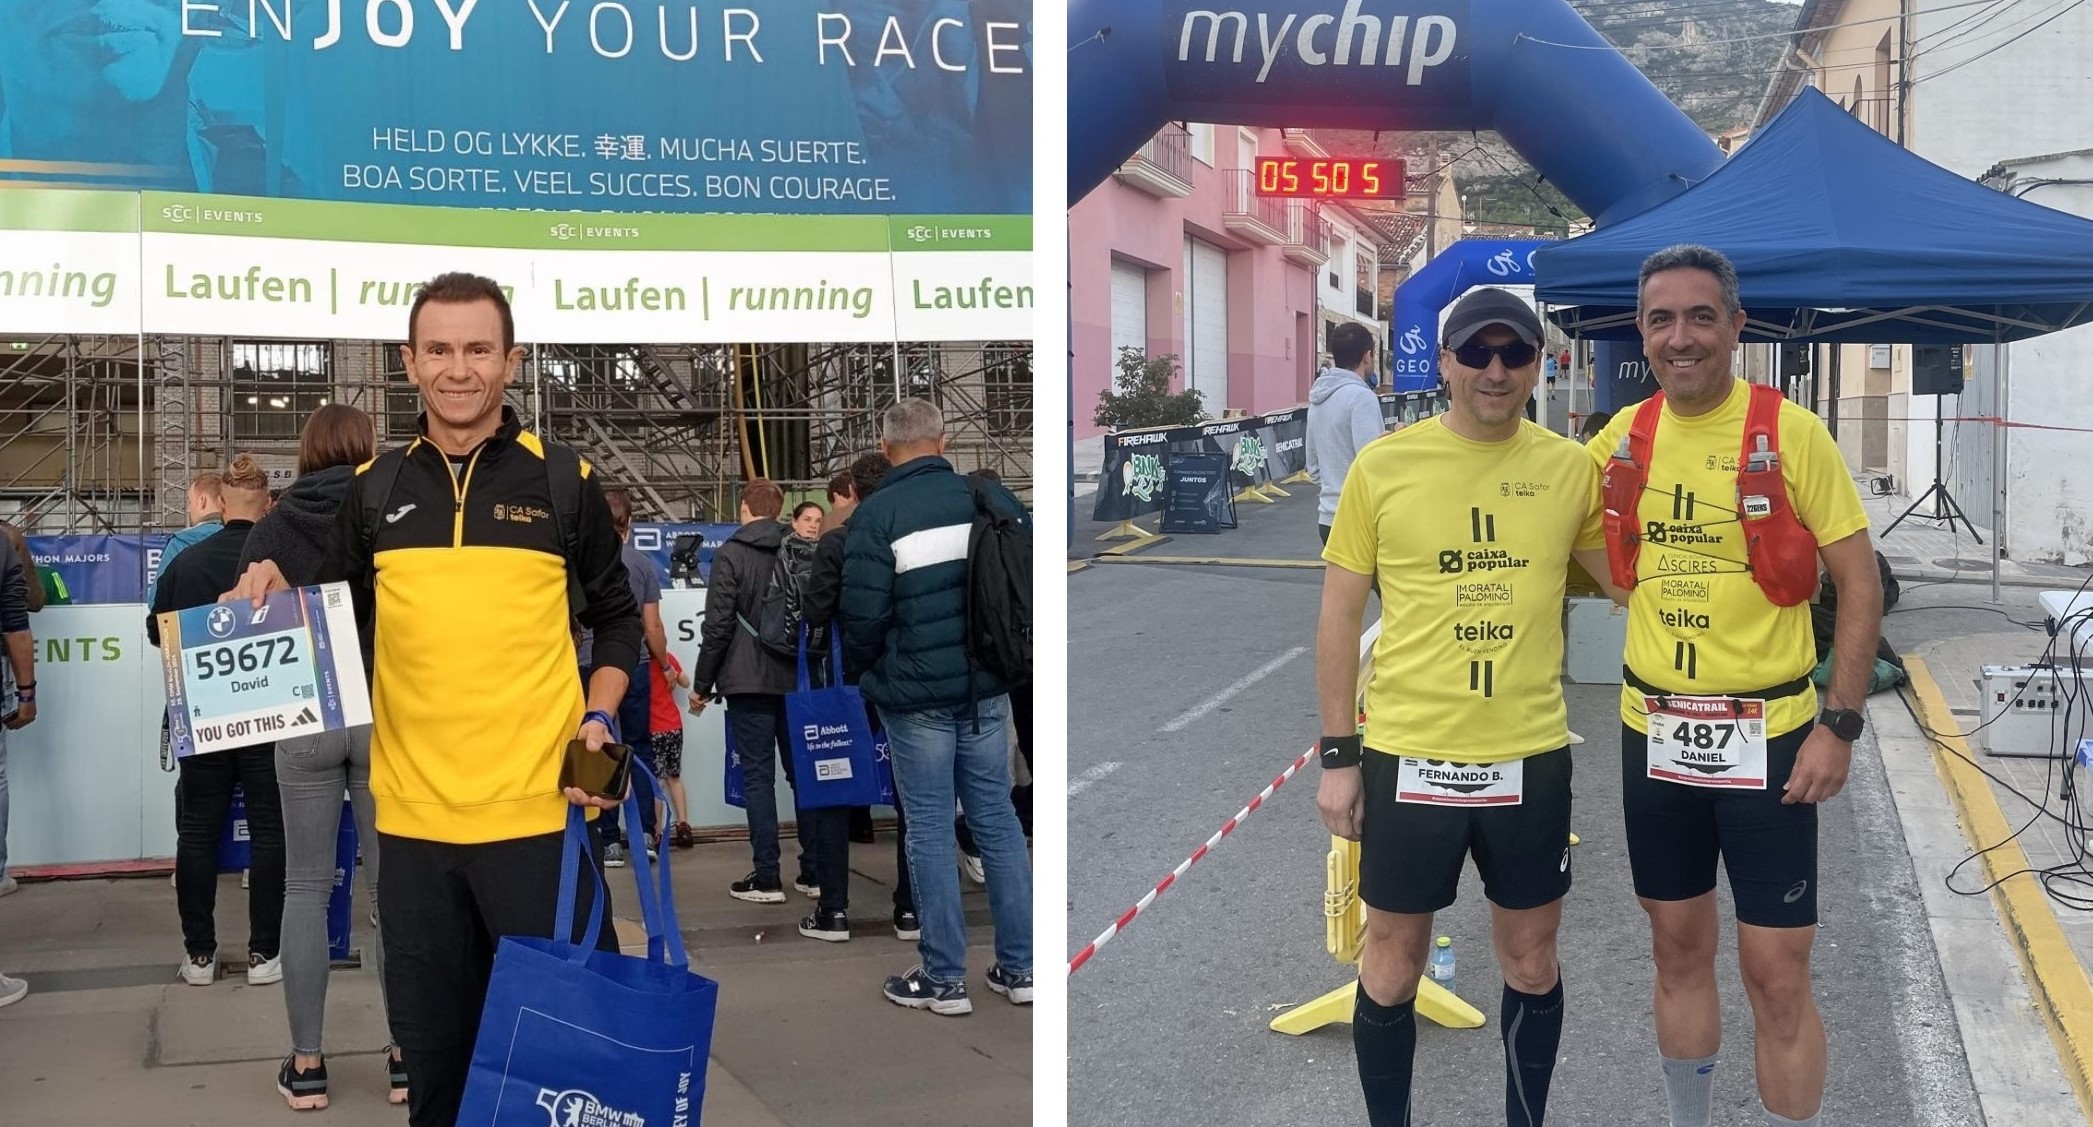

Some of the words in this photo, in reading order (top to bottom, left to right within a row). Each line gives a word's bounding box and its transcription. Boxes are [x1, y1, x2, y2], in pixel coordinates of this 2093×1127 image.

[181, 0, 477, 51] ENJOY
[527, 0, 763, 63] YOUR
[818, 12, 1024, 74] RACE
[1178, 0, 1457, 85] mychip
[372, 127, 445, 153] HELD
[454, 131, 492, 155] OG
[501, 132, 587, 158] LYKKE.
[660, 137, 754, 162] MUCHA
[761, 140, 867, 165] SUERTE.
[344, 164, 402, 190] BOA
[409, 167, 508, 193] SORTE.
[514, 170, 582, 195] VEEL
[590, 173, 698, 198] SUCCES.
[706, 175, 761, 199] BON
[770, 177, 896, 201] COURAGE.
[1260, 161, 1298, 192] 05
[1312, 162, 1349, 193] 50
[1362, 163, 1379, 194] 5
[204, 210, 263, 223] EVENTS
[586, 227, 639, 239] EVENTS
[942, 228, 991, 240] EVENTS
[166, 264, 312, 304] Laufen
[554, 278, 686, 312] Laufen
[729, 279, 874, 319] running
[912, 279, 1033, 310] Laufen
[1396, 359, 1430, 373] GEO
[1118, 432, 1169, 448] FIREHAWK
[1180, 476, 1207, 484] JUNTOS
[1514, 482, 1527, 490] CA
[509, 505, 523, 514] CA
[1670, 533, 1723, 545] popular
[64, 553, 110, 563] MAJORS
[1467, 549, 1507, 560] caixa
[1467, 557, 1529, 572] popular
[1459, 584, 1509, 593] MORATAL
[1663, 580, 1706, 589] MORATAL
[1459, 592, 1510, 602] PALOMINO
[1663, 588, 1706, 598] PALOMINO
[1659, 607, 1709, 629] teika
[1454, 620, 1513, 641] teika
[196, 635, 299, 680] 59672
[231, 675, 269, 694] David
[196, 728, 222, 743] YOU
[226, 720, 251, 738] GOT
[254, 713, 286, 733] THIS
[820, 723, 849, 736] Abbott
[1672, 721, 1735, 750] 487
[1681, 750, 1726, 763] DANIEL
[1418, 768, 1489, 782] FERNANDO
[1492, 771, 1504, 781] B.
[678, 1072, 691, 1094] JOY
[584, 1100, 623, 1122] BMW
[675, 1097, 689, 1112] OF
[582, 1114, 622, 1127] BERLIN
